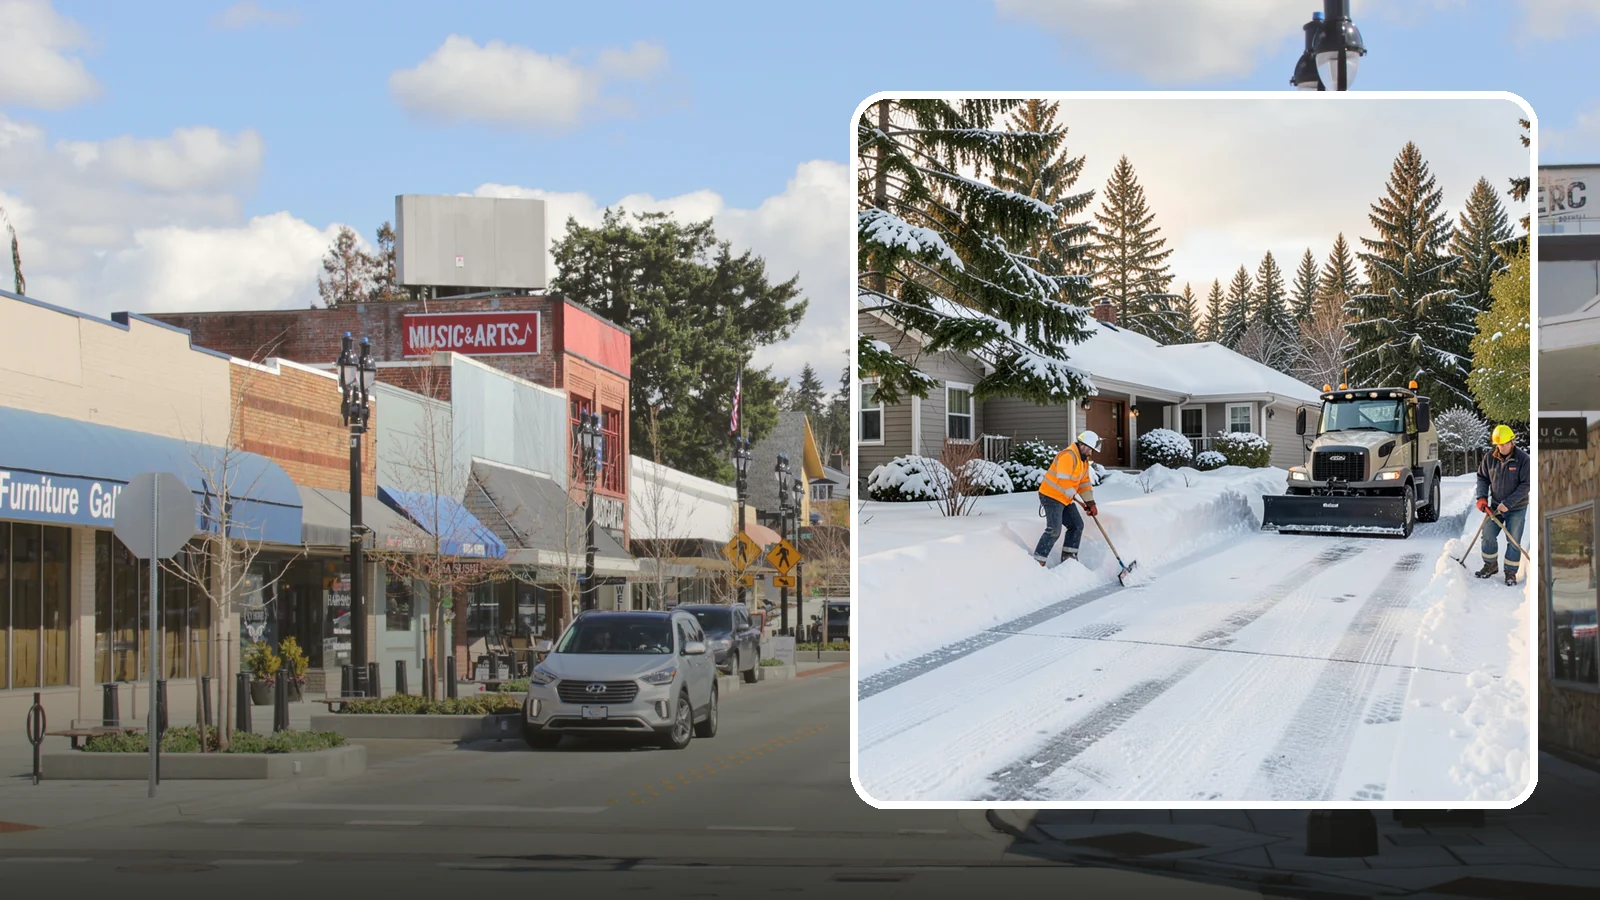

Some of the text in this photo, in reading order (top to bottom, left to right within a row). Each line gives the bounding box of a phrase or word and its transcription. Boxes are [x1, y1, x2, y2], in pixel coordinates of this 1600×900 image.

[409, 322, 519, 349] MUSIC&ARTS
[0, 472, 79, 515] Furniture
[453, 562, 479, 574] SUSHI
